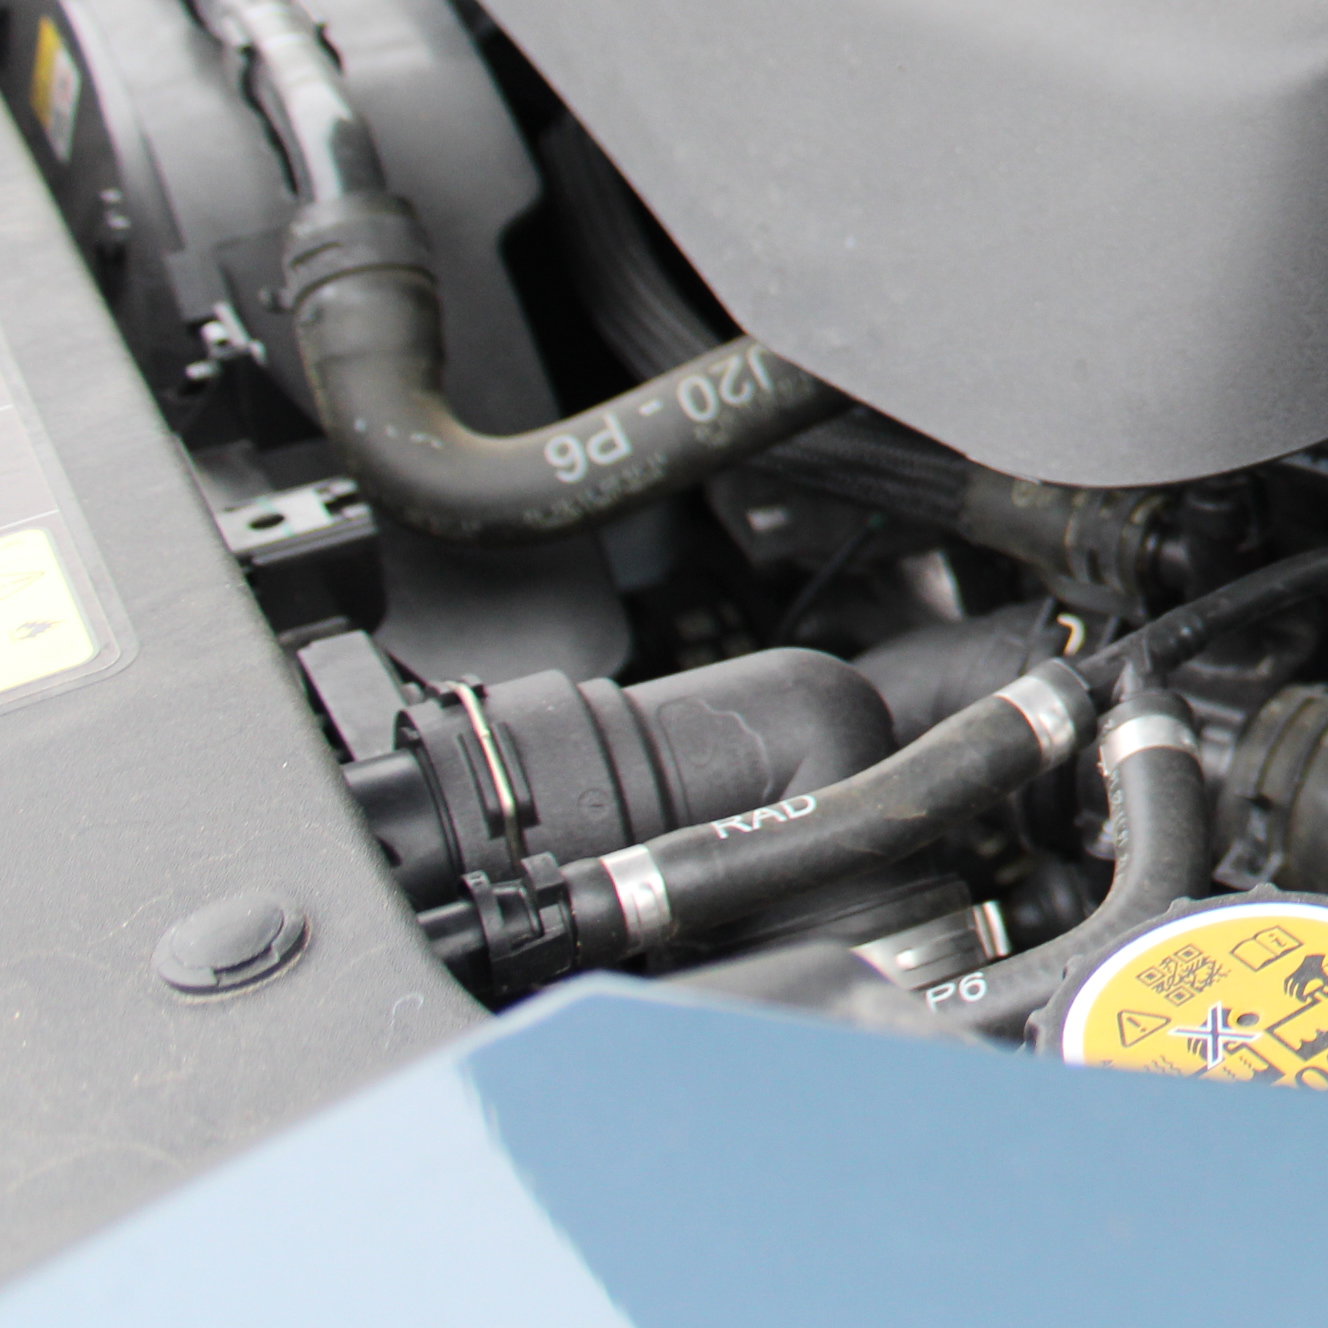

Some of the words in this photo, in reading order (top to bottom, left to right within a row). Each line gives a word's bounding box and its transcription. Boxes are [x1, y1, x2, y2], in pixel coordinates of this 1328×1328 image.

[676, 343, 776, 422] J20
[544, 413, 633, 483] P6
[711, 794, 817, 840] RAD
[926, 971, 987, 1013] P6
